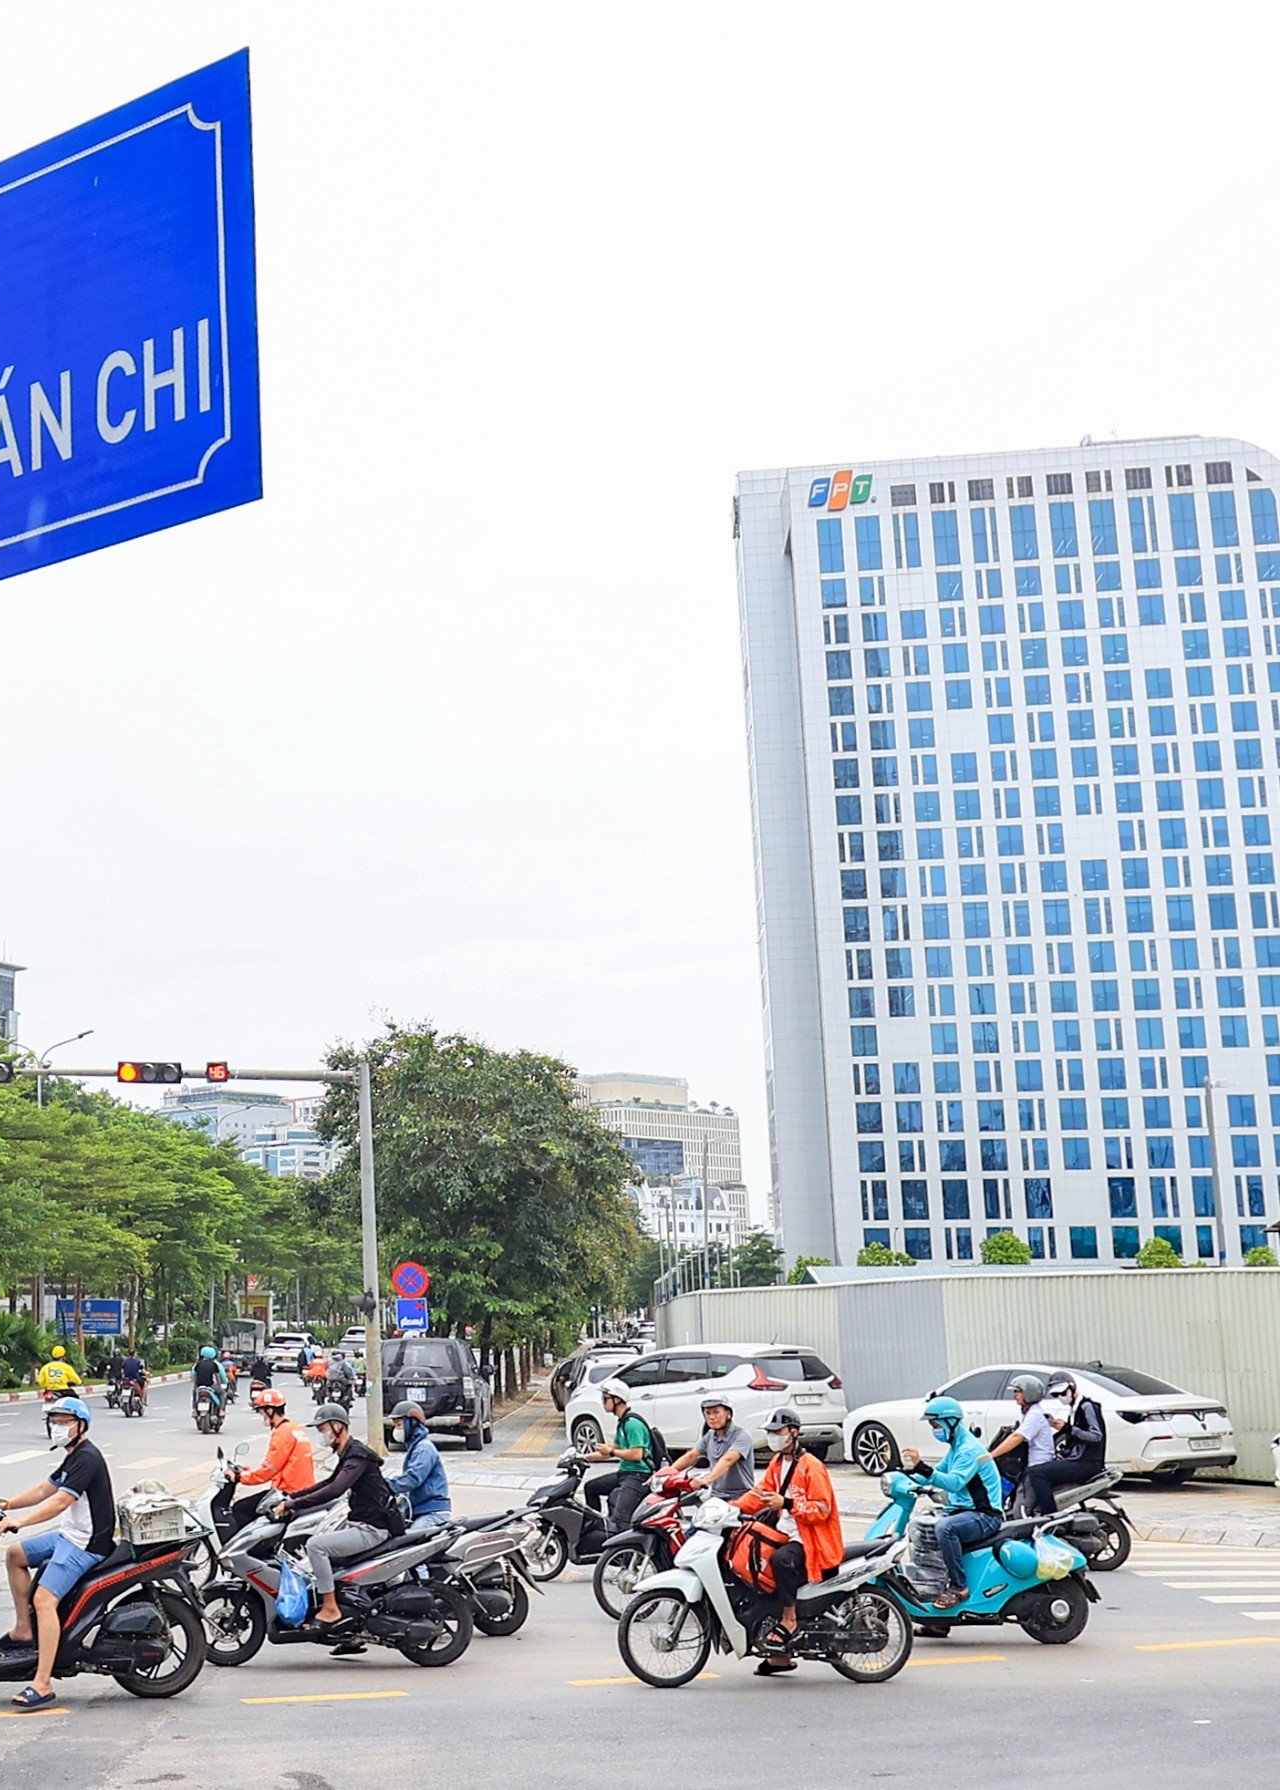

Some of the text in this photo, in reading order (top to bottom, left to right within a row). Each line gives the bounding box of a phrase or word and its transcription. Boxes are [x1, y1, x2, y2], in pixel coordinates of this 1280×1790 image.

[96, 318, 211, 444] CHI
[207, 1065, 225, 1079] 46
[48, 1366, 64, 1378] be
